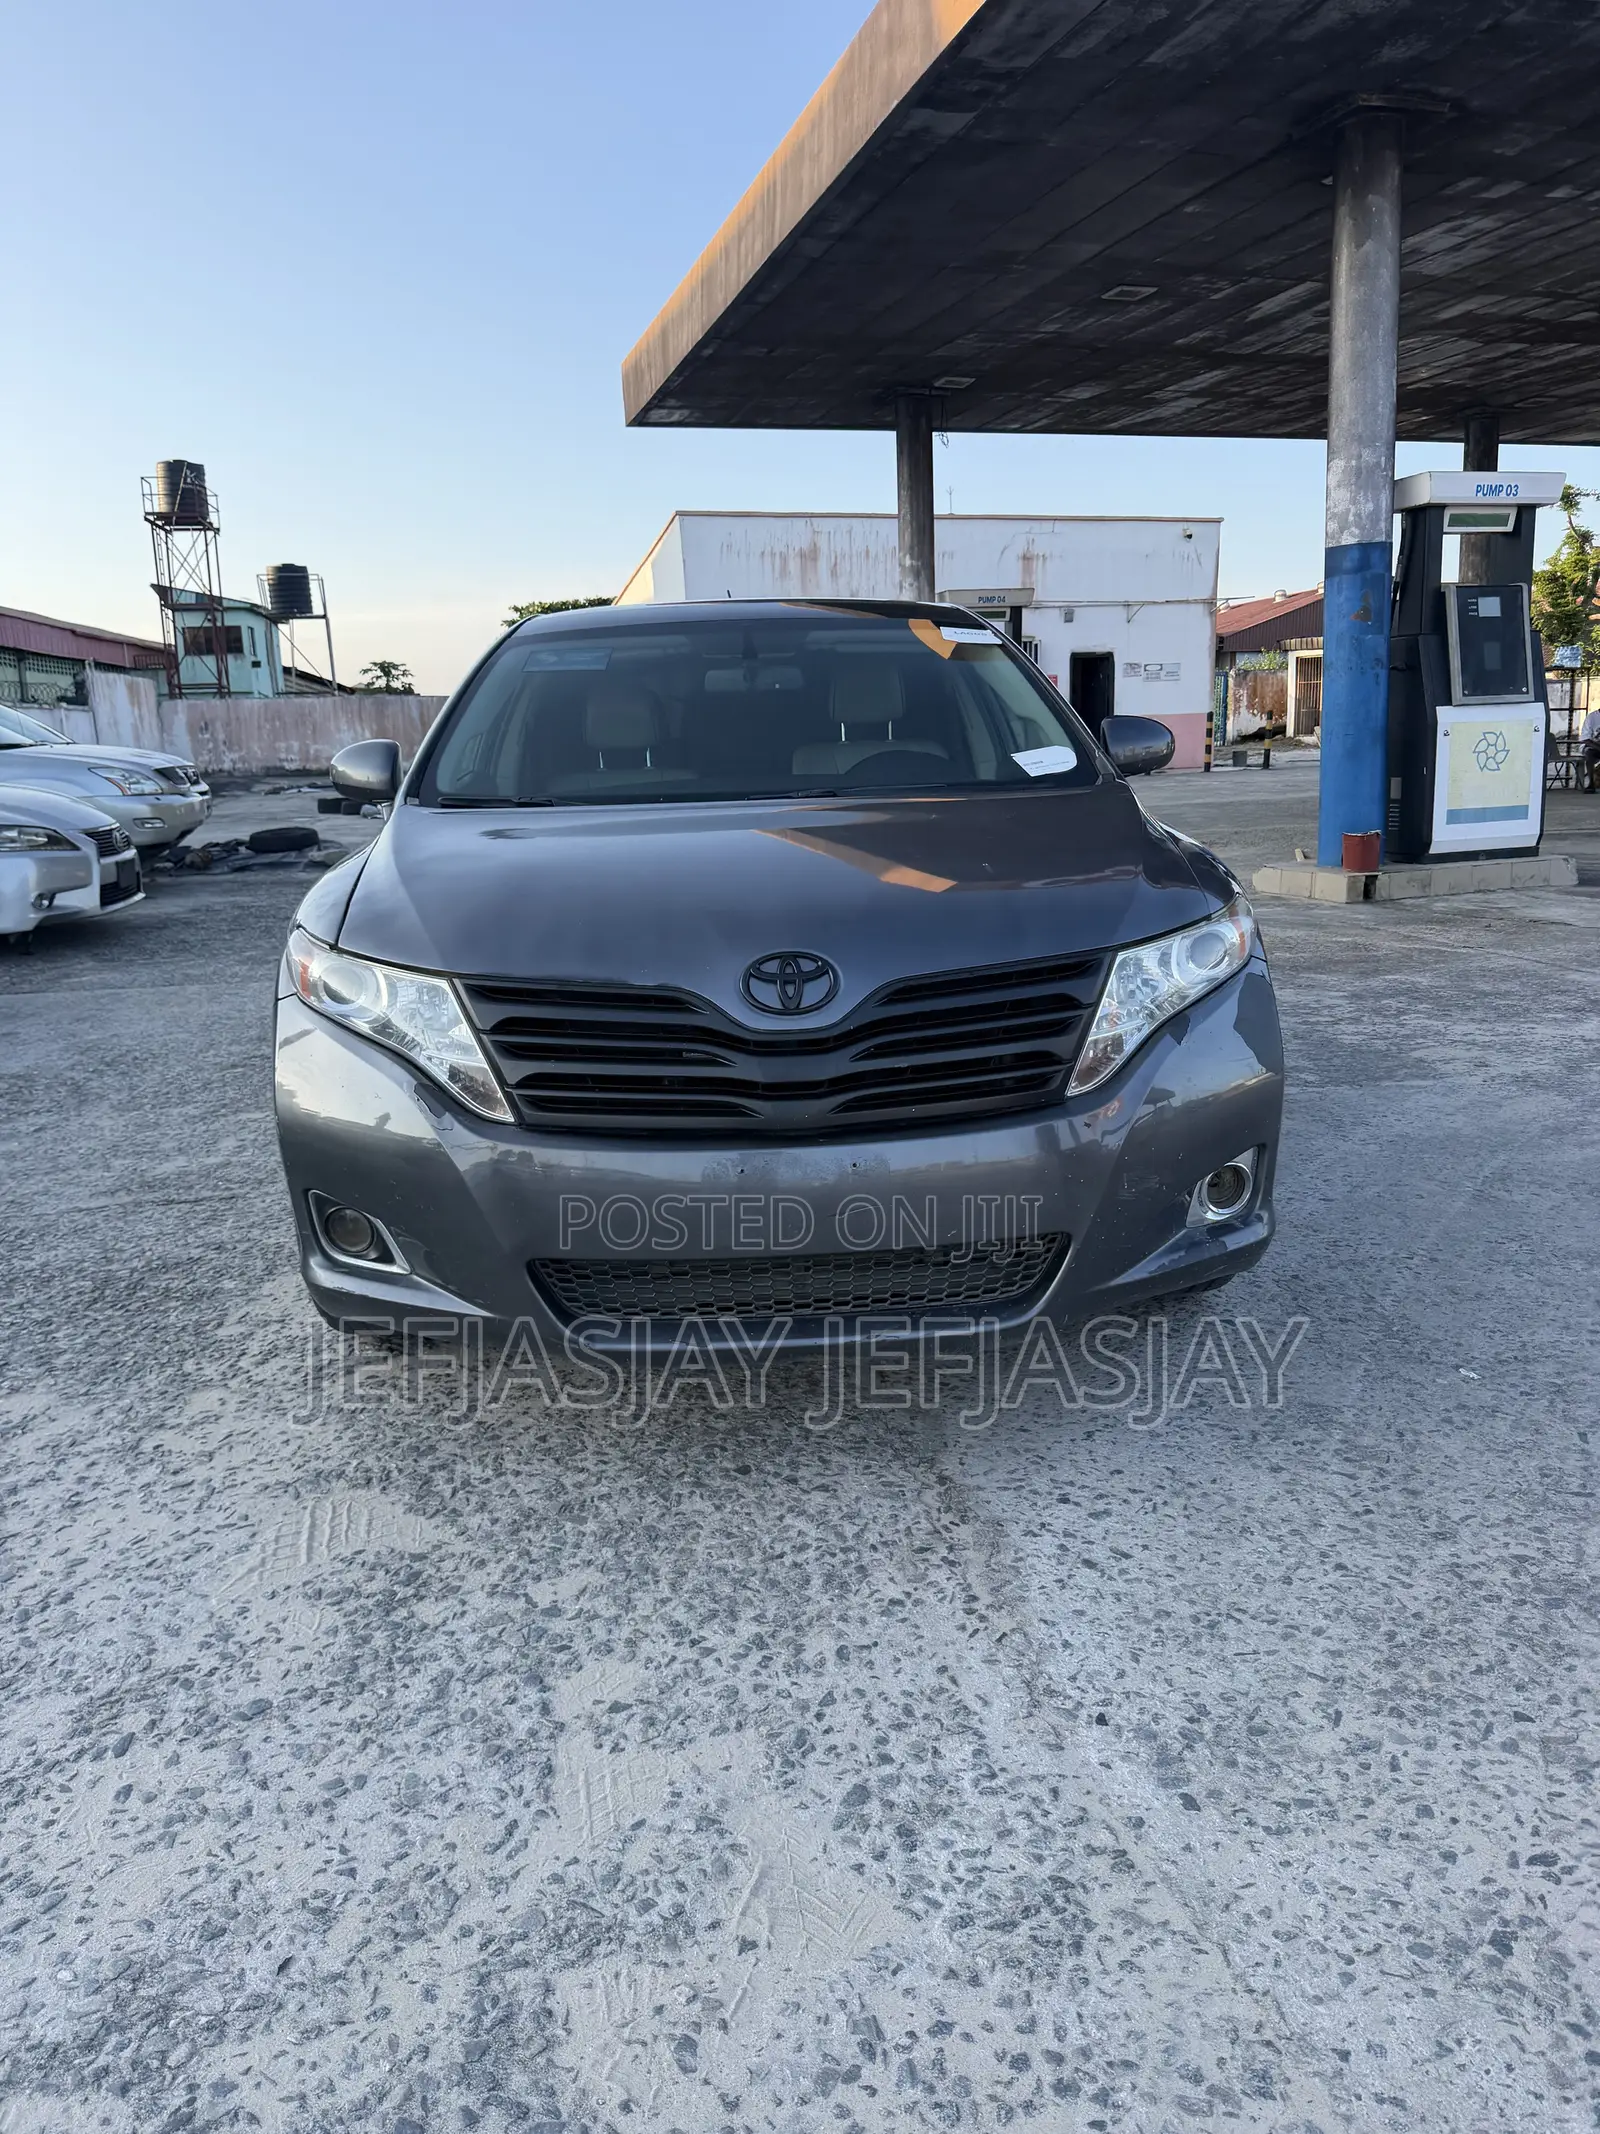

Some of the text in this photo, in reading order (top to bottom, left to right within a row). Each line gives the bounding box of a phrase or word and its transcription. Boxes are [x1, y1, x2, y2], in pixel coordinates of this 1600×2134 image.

[1475, 484, 1519, 497] PUMP 03
[978, 595, 1006, 604] PUMP 04
